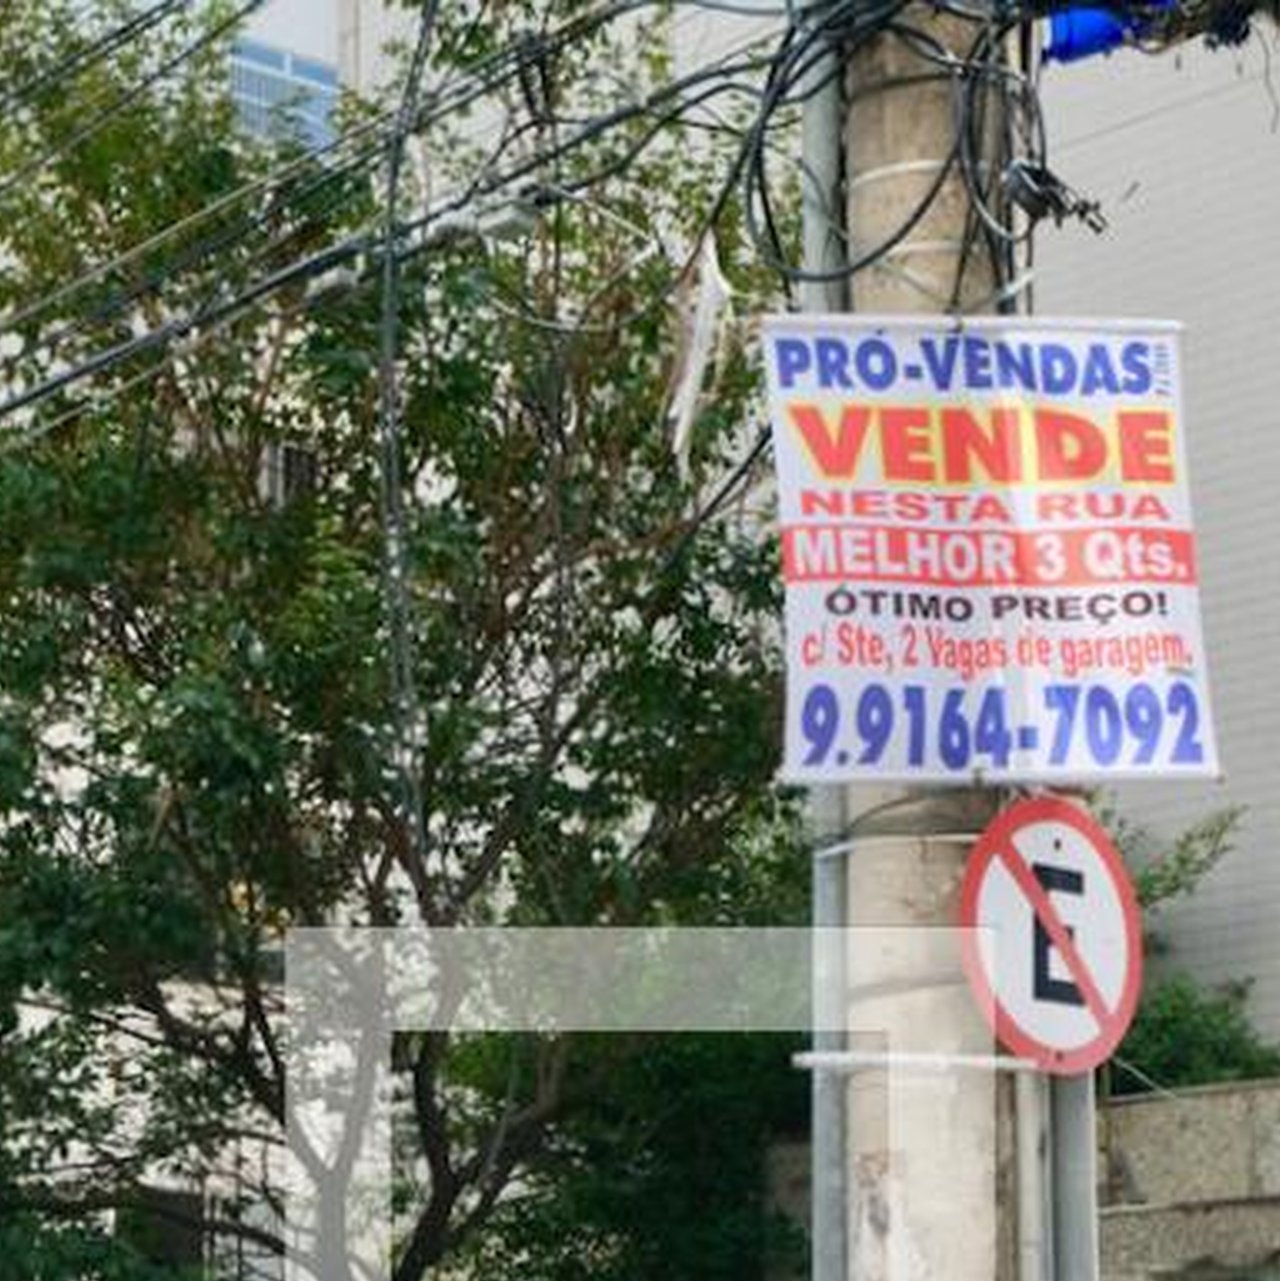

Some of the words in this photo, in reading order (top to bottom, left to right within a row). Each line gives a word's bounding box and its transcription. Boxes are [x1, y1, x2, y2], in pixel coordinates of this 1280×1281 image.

[788, 404, 1177, 484] VENDE
[801, 492, 1011, 521] NESTA
[1036, 494, 1169, 521] RUA
[795, 531, 1015, 580] MELHOR
[1036, 536, 1066, 579] 3
[1084, 536, 1188, 579] Qts.
[825, 585, 973, 621] ÓTIMO
[991, 591, 1167, 625] PREÇO!
[903, 623, 918, 667] 2
[926, 627, 1007, 680] Vagas
[1017, 628, 1051, 667] de
[801, 683, 1204, 770] 9.9164-7092
[1032, 863, 1085, 1007] E
